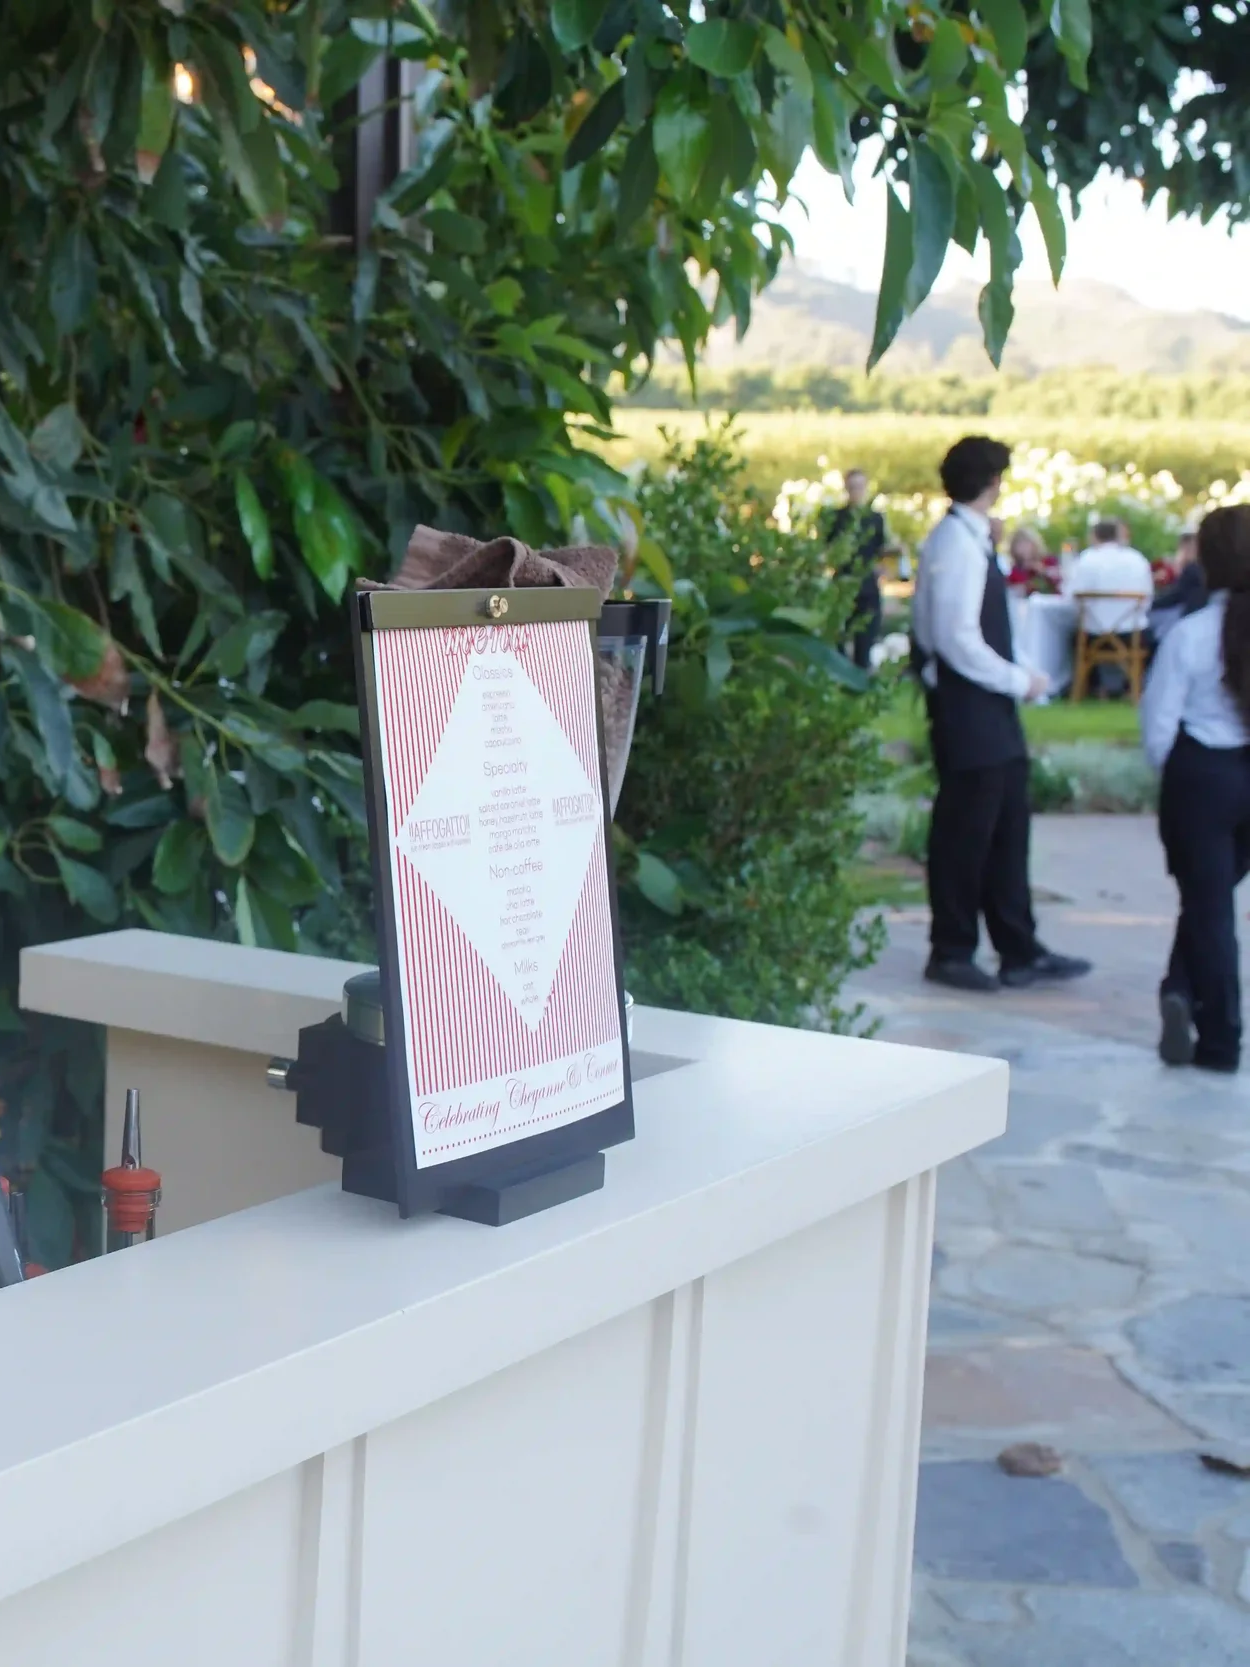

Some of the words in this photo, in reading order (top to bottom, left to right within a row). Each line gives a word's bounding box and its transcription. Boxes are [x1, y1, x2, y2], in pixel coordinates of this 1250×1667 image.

[443, 624, 530, 657] menu
[472, 664, 514, 681] Classics
[482, 760, 528, 780] Specialty
[489, 858, 544, 880] Non-coffee
[514, 959, 539, 977] Milks
[417, 1100, 501, 1135] Celebrating
[504, 1076, 567, 1116] Cheyanne
